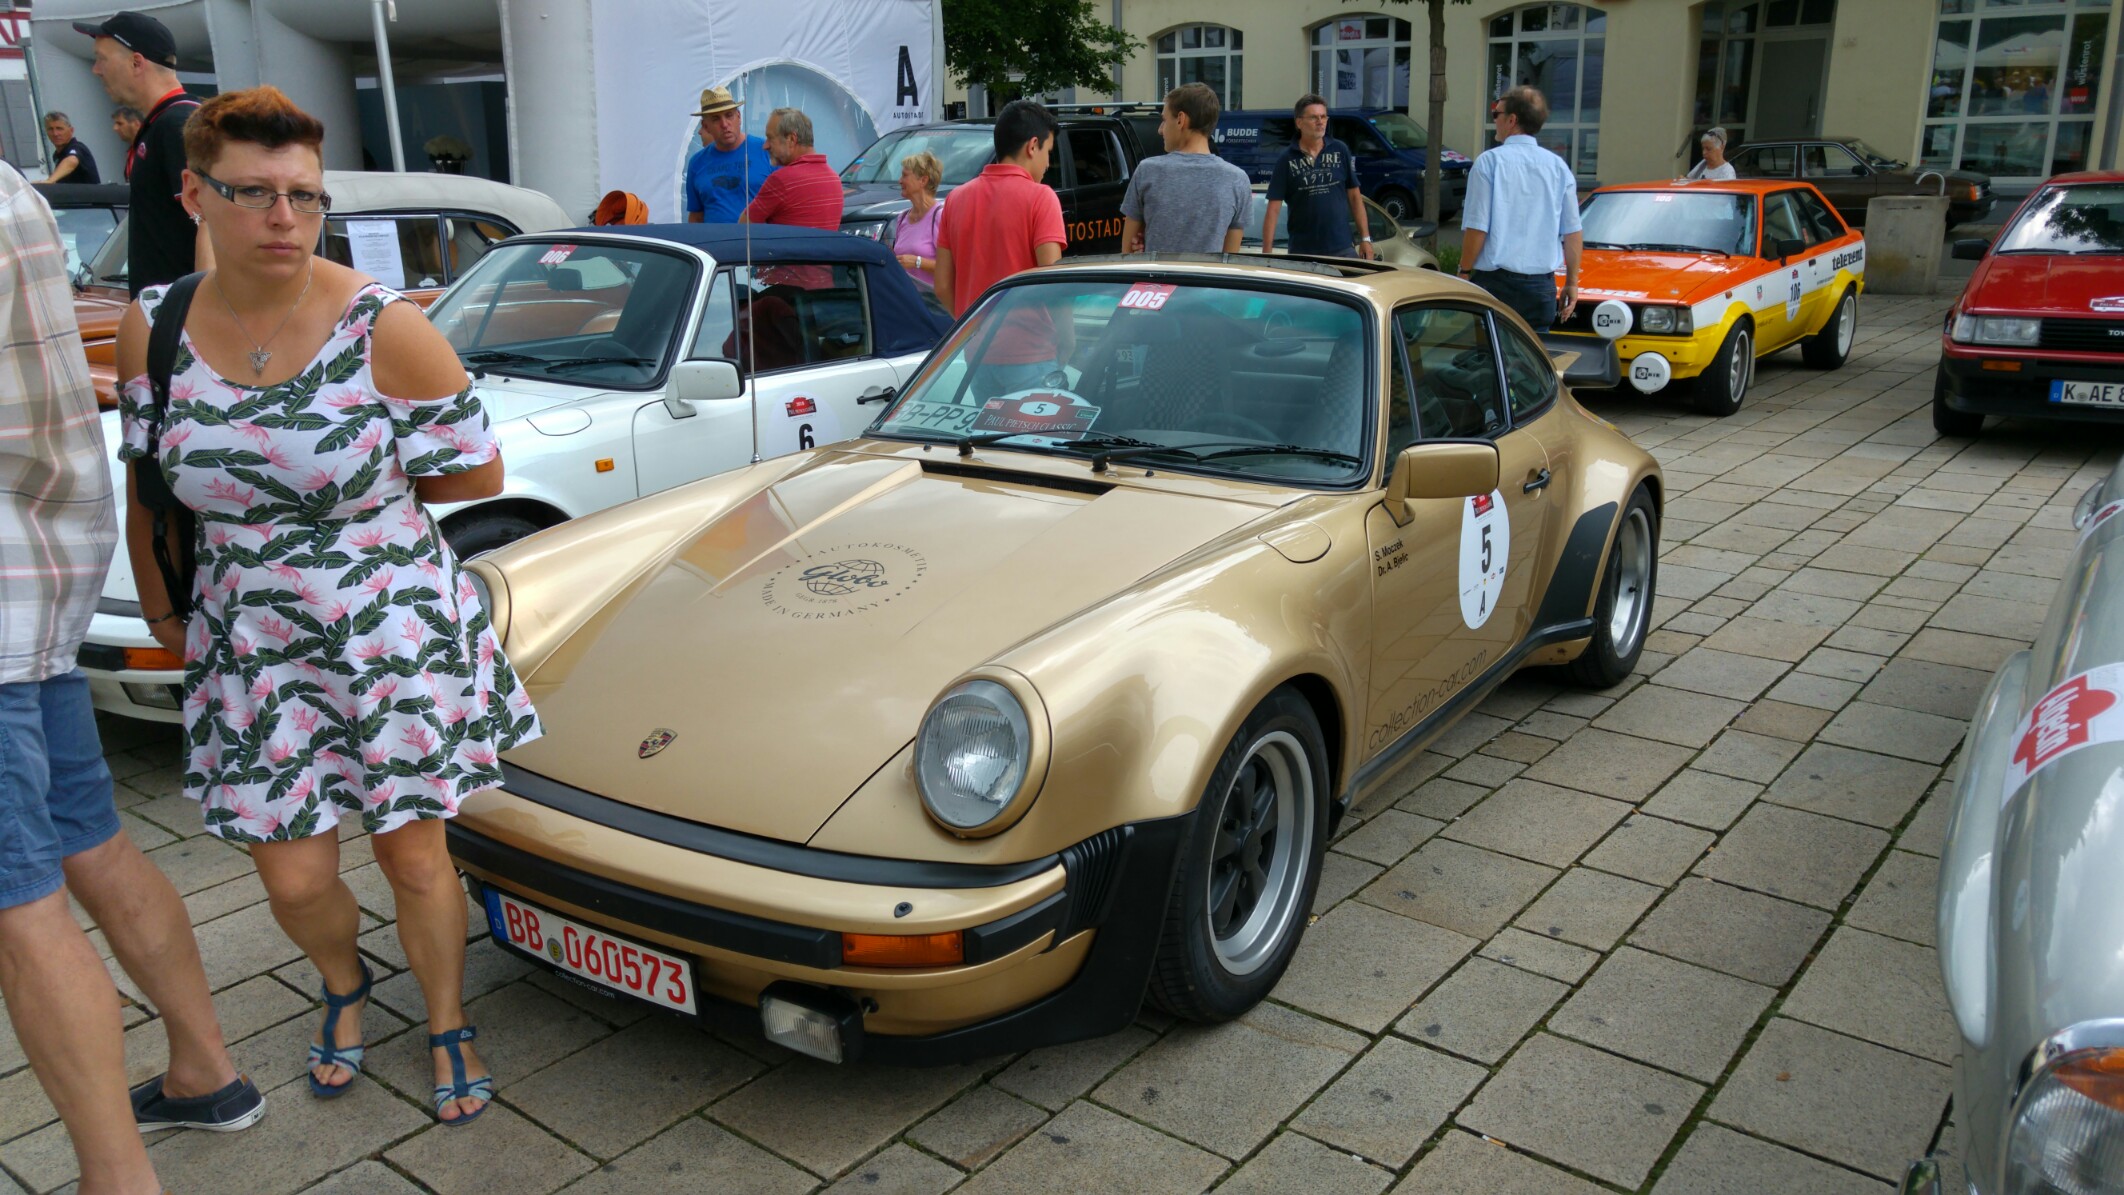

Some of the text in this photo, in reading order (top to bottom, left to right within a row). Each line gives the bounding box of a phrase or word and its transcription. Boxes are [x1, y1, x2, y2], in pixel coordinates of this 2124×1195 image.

[897, 46, 919, 106] A
[1227, 128, 1259, 137] BUDDE
[1068, 216, 1127, 242] TOSTAD
[540, 250, 571, 263] 006
[1121, 290, 1169, 309] 005
[1790, 281, 1801, 303] 106
[2064, 383, 2077, 400] K
[2089, 385, 2115, 402] AE
[1033, 403, 1048, 414] 5
[983, 414, 1004, 427] PAUL
[1007, 418, 1040, 431] PIETSCH
[798, 423, 815, 451] 6
[818, 542, 928, 573] AUTOKOSMETIK
[1374, 550, 1383, 562] S.
[1481, 524, 1492, 574] 5
[798, 565, 889, 588] Globo
[1377, 565, 1387, 577] Dr.
[761, 581, 880, 620] MADE IN GERMANY
[1478, 590, 1486, 618] A
[1368, 649, 1487, 750] collection-car.com
[2027, 686, 2081, 761] Alpecin
[505, 901, 687, 1005] BB 060573
[554, 970, 616, 999] collection-car.com
